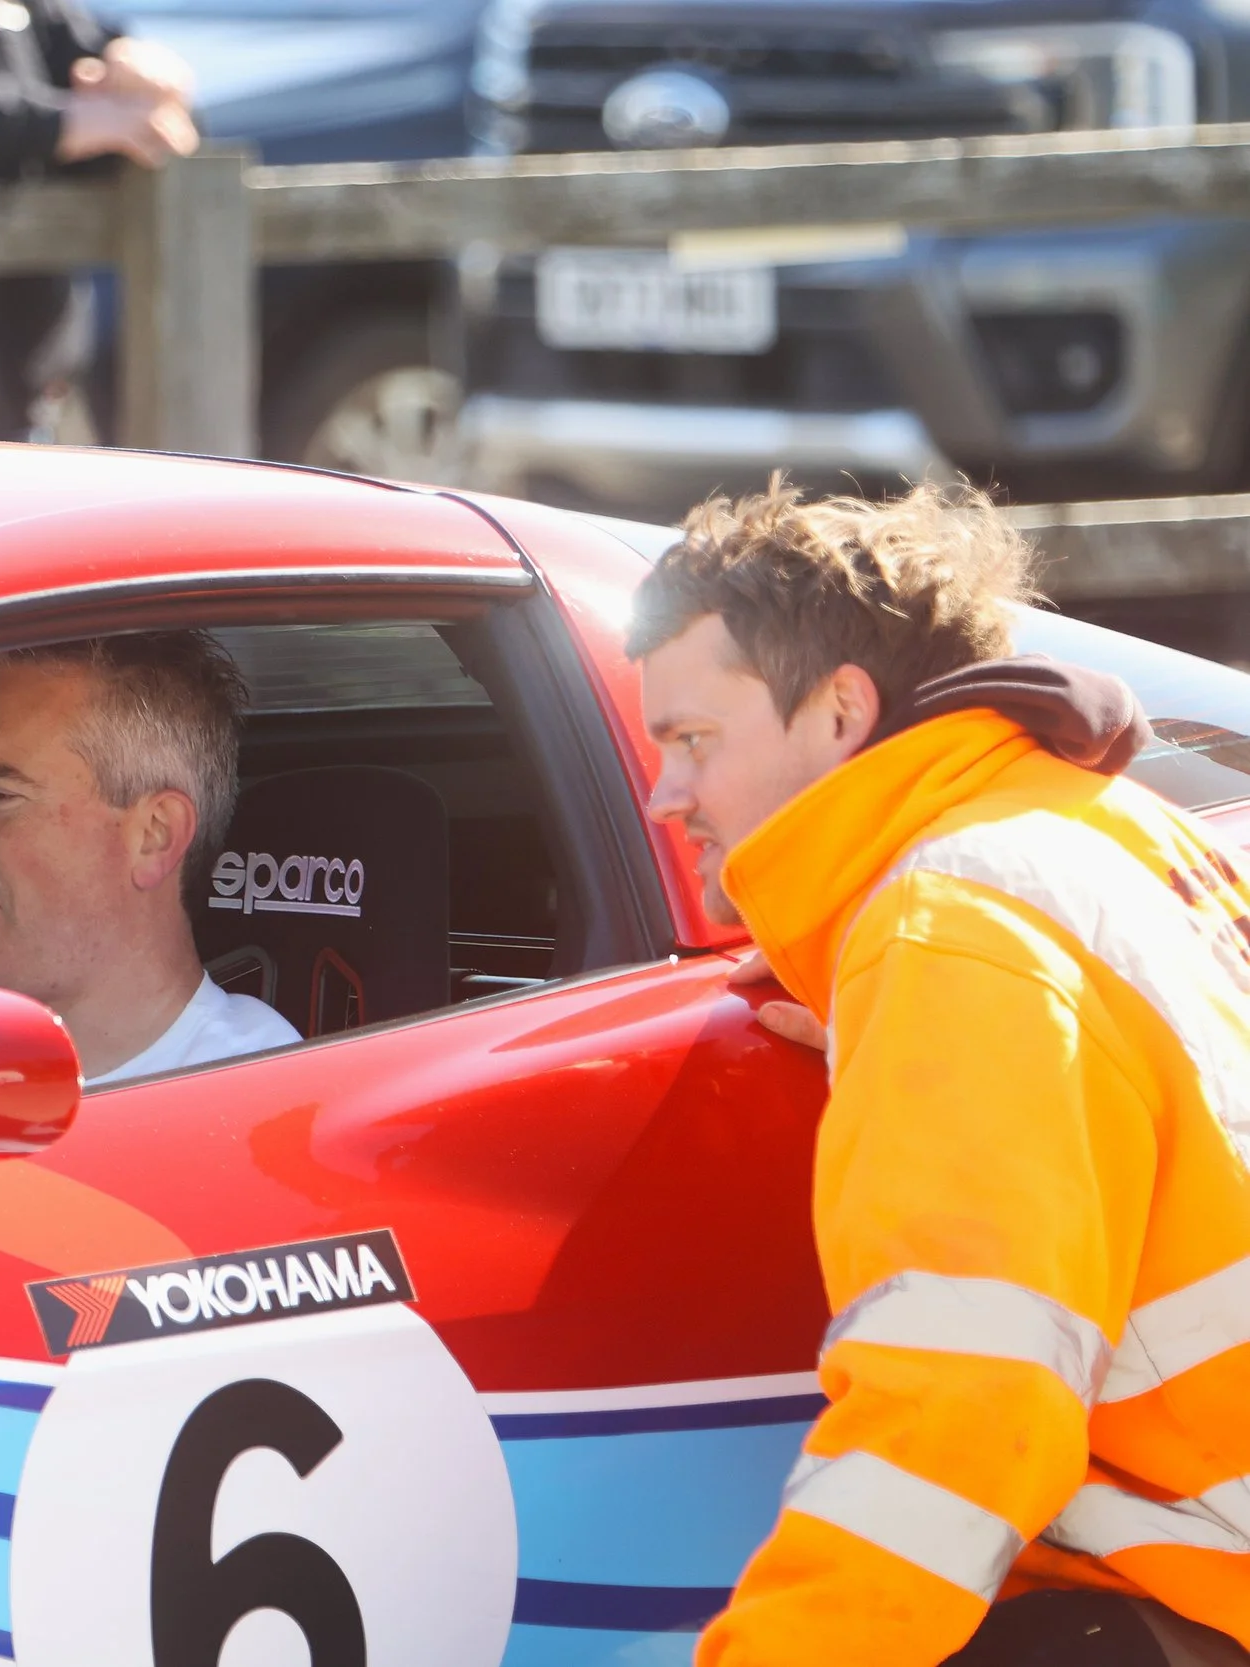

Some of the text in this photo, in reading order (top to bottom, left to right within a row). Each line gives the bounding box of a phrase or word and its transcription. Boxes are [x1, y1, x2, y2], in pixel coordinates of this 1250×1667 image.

[211, 851, 365, 915] sparco
[126, 1244, 396, 1328] YOKOHAMA
[150, 1377, 368, 1667] 6
